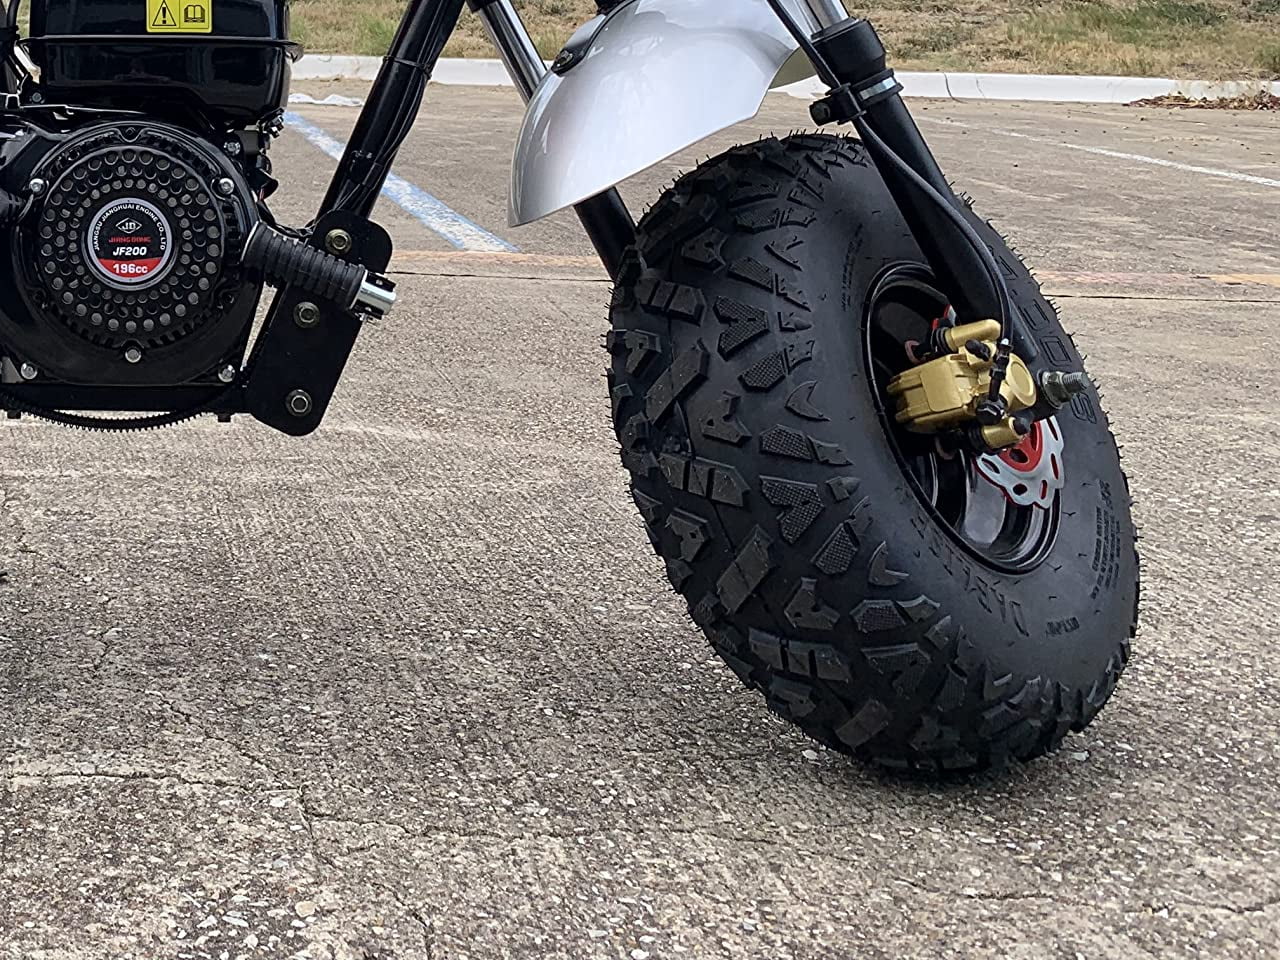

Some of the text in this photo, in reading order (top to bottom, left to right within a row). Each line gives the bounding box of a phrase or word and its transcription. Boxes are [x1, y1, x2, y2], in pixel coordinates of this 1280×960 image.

[135, 204, 159, 223] ENGINE
[112, 246, 148, 256] JF200
[113, 263, 148, 274] 196cc
